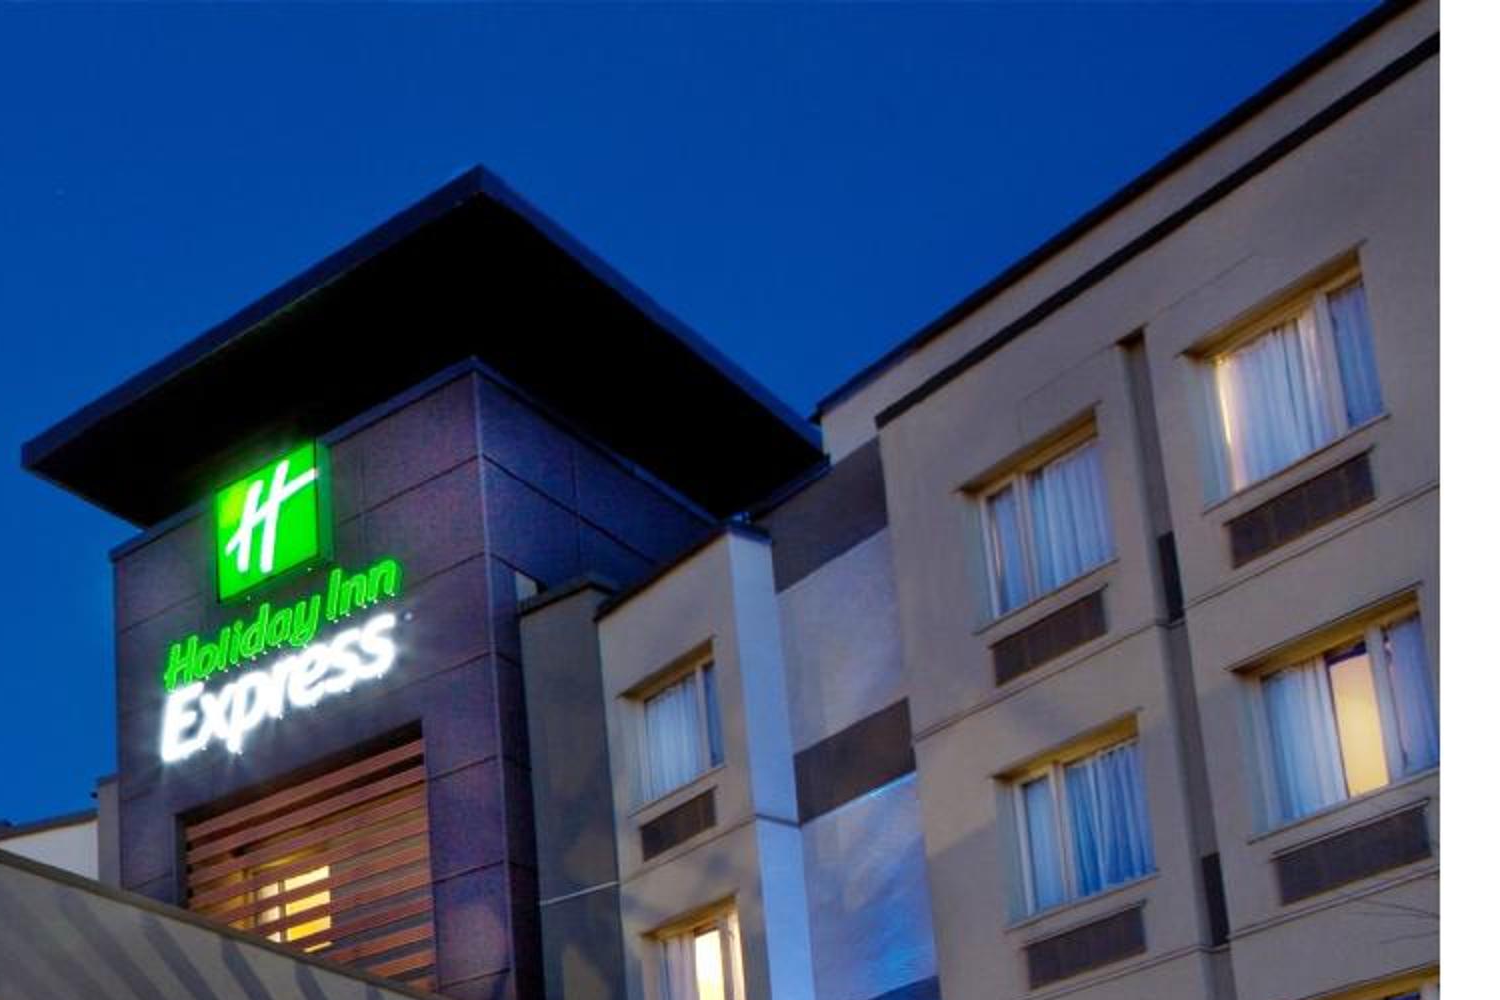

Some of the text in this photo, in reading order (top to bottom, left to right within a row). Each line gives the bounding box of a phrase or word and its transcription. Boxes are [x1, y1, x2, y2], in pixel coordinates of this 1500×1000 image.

[161, 613, 397, 762] Express
[164, 560, 397, 690] Holiday Inn
